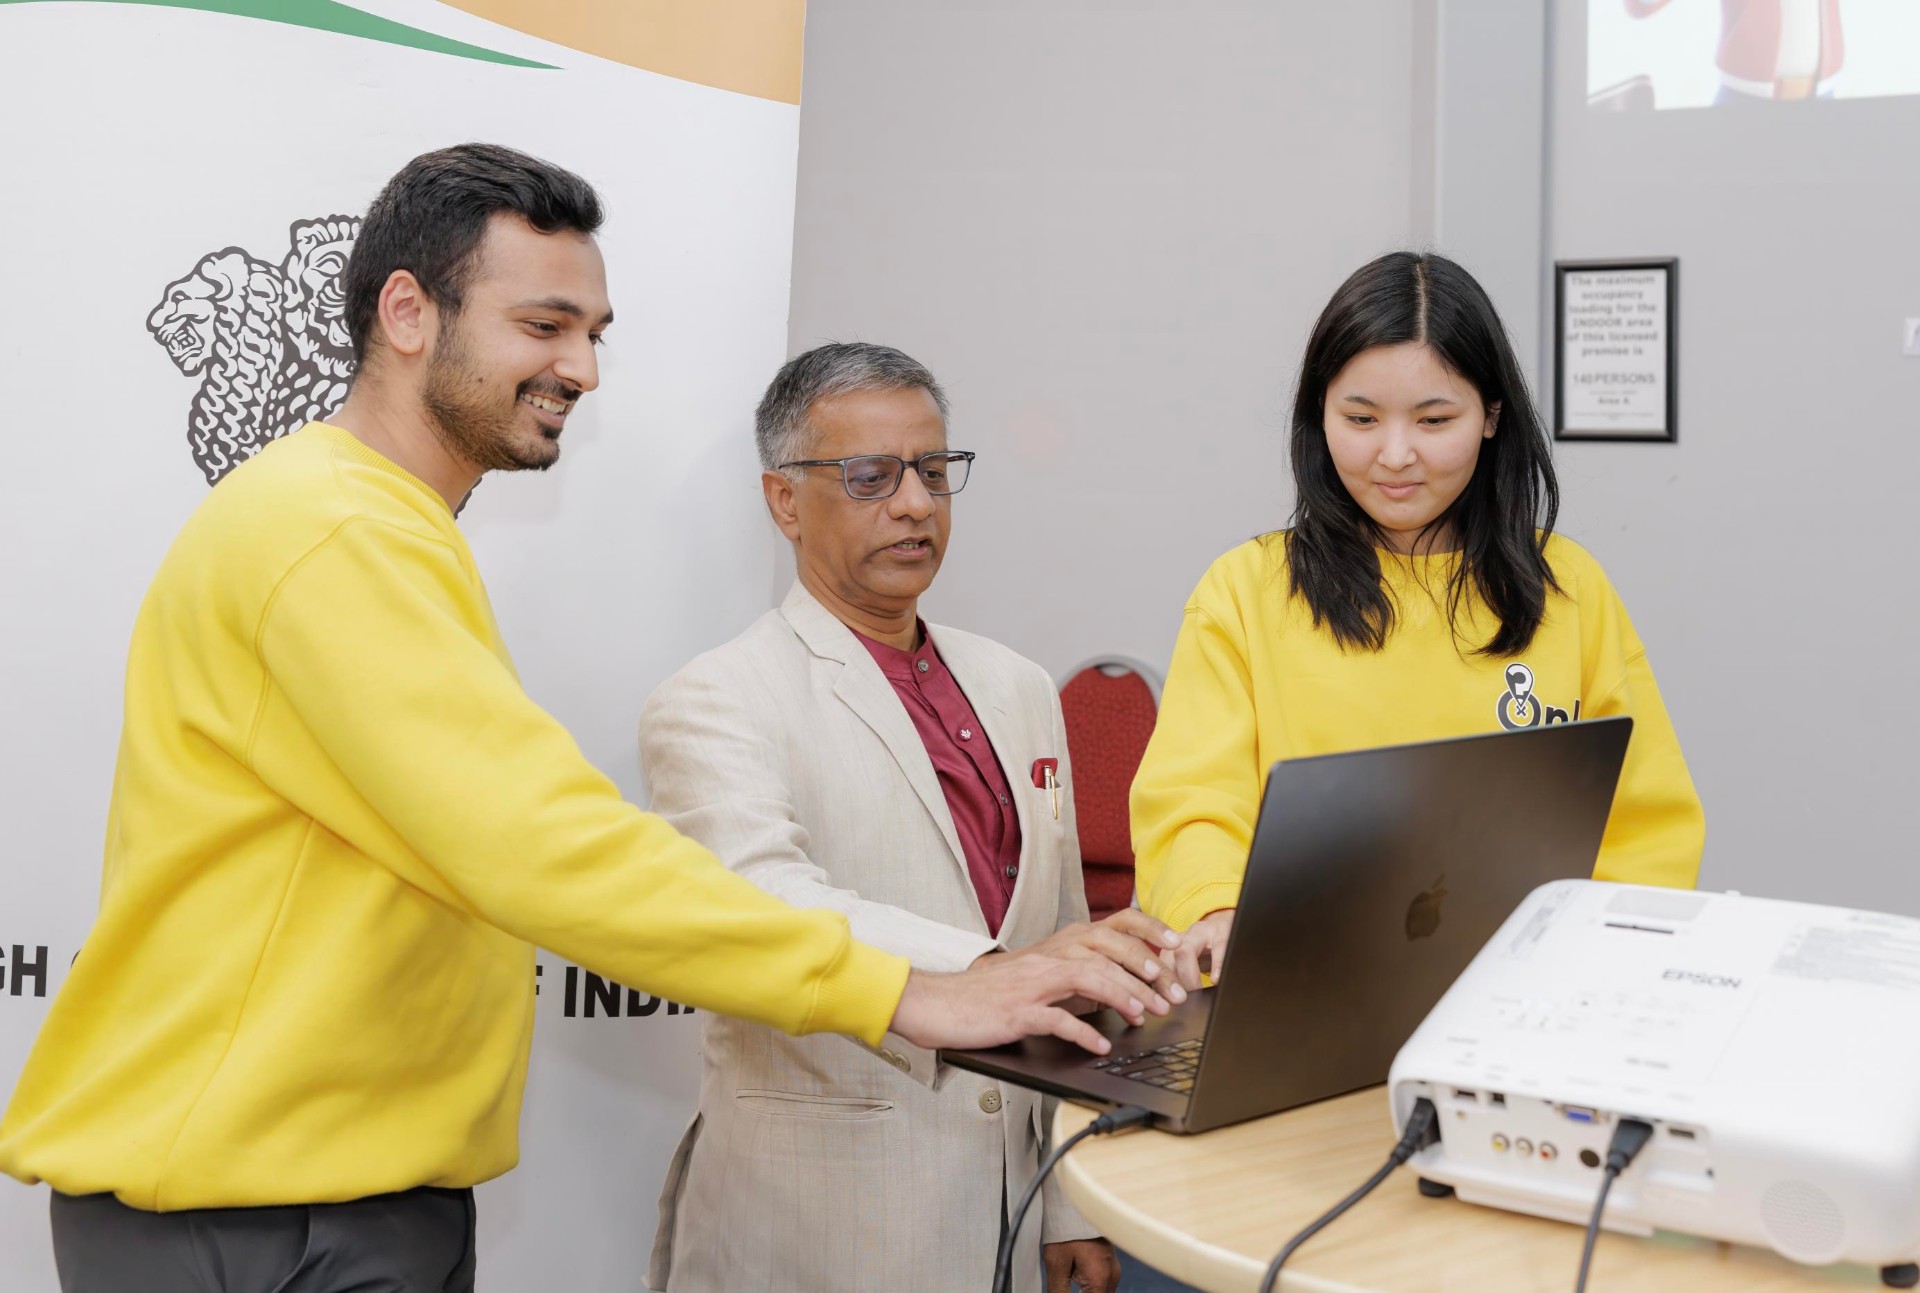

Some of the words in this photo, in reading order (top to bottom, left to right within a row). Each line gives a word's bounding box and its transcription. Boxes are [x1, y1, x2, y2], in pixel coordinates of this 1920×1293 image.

[1571, 275, 1591, 285] The
[1595, 275, 1655, 285] maximum
[1581, 290, 1643, 301] occupancy
[1568, 304, 1612, 314] loading
[1616, 303, 1634, 313] for
[1637, 303, 1656, 313] the
[1573, 318, 1622, 328] INDOOR
[1626, 318, 1653, 328] area
[1567, 331, 1580, 341] of
[1582, 331, 1605, 341] this
[1608, 330, 1658, 341] licensed
[1581, 346, 1628, 357] premise
[1633, 345, 1643, 355] is
[0, 944, 48, 998] H
[1661, 967, 1742, 989] EPSON
